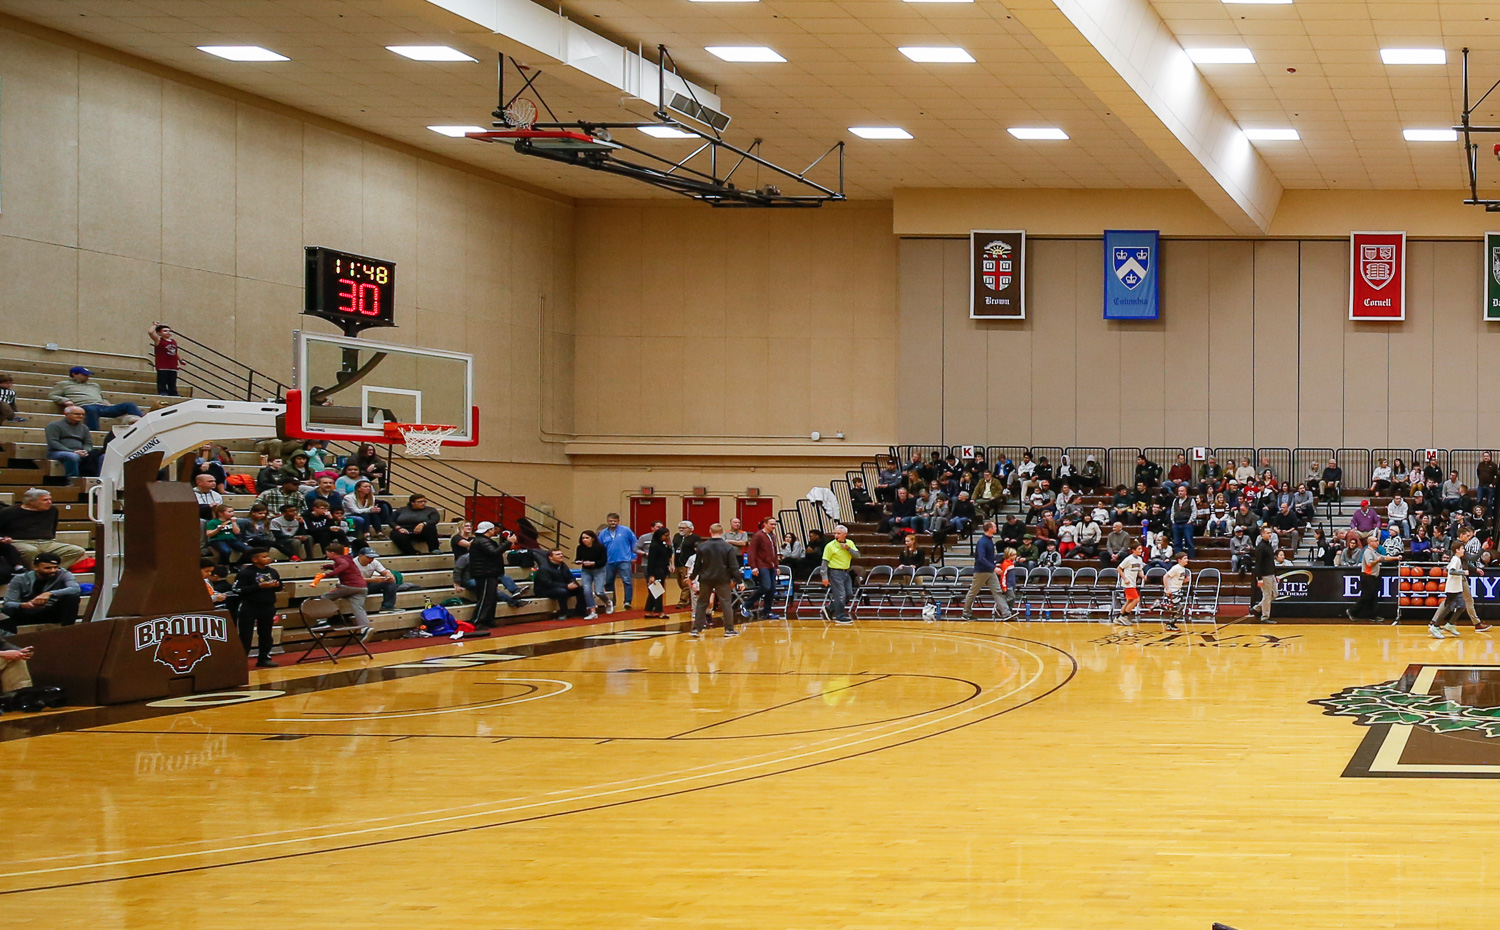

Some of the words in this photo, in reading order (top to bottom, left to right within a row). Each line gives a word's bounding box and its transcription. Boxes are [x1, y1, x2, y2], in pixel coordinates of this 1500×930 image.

[335, 259, 388, 284] 11:48
[338, 278, 380, 316] 30
[985, 296, 1010, 305] Brown
[1363, 298, 1391, 307] Cornell
[963, 448, 972, 456] K
[1195, 449, 1203, 458] L
[1426, 451, 1436, 459] M
[134, 614, 228, 651] BROWN
